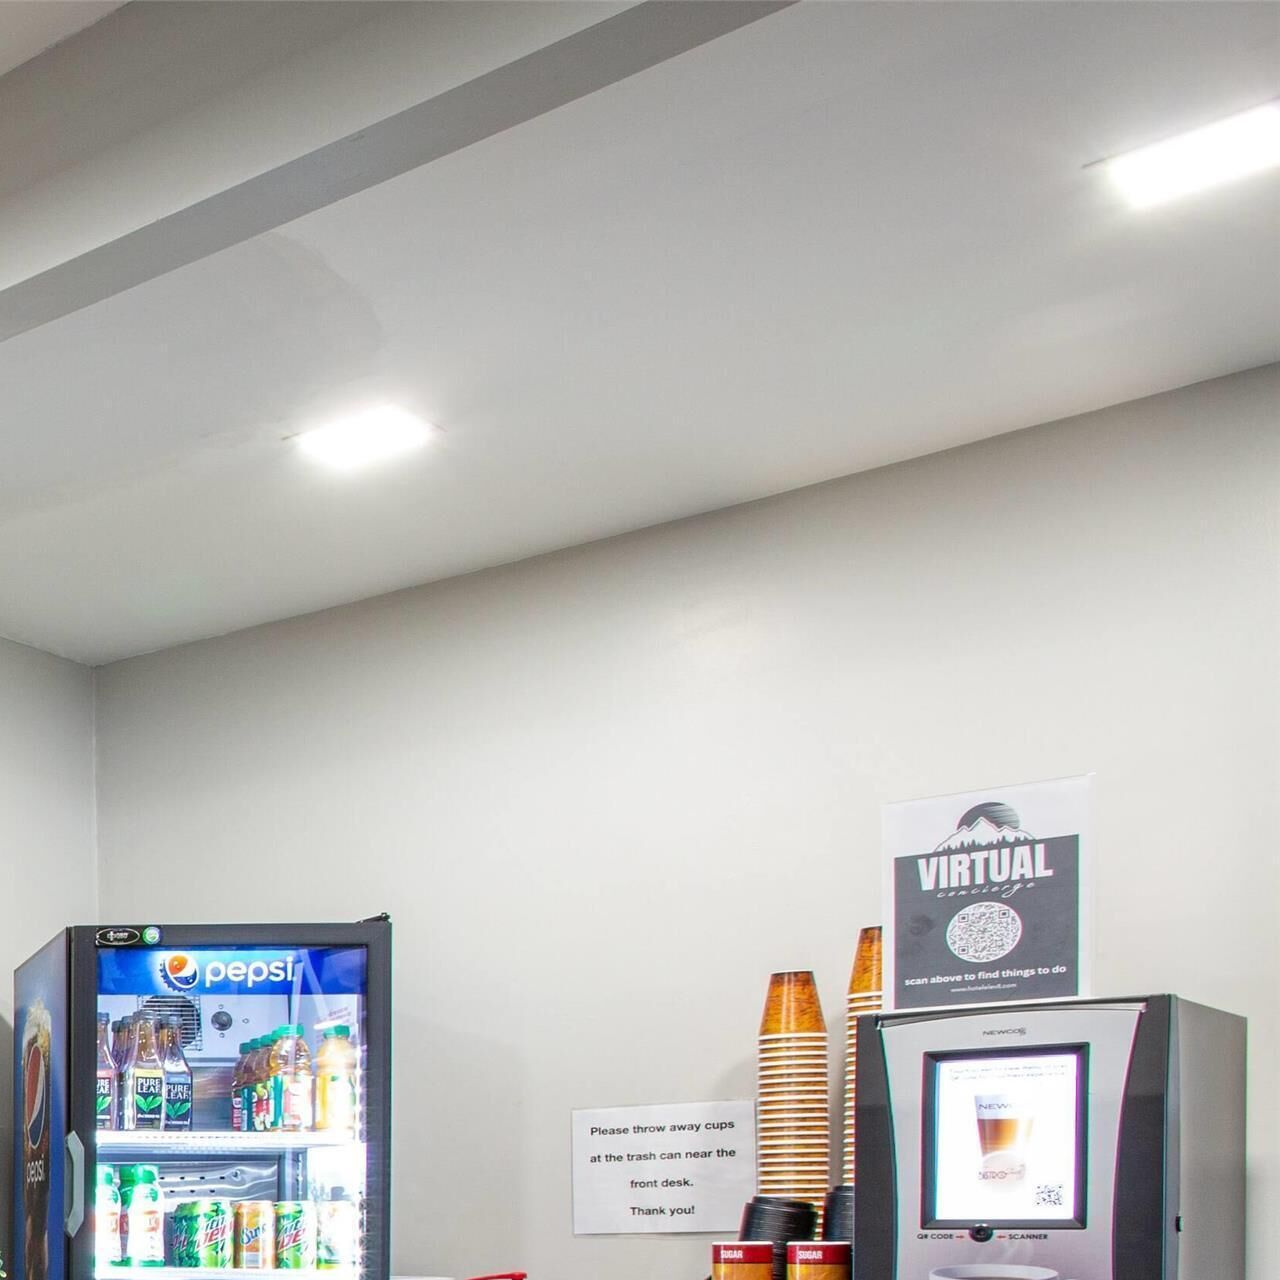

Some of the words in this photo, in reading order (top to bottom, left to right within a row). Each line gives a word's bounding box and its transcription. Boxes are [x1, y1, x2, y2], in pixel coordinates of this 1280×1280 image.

[917, 843, 1054, 891] VIRTUAL
[937, 882, 1036, 898] concierge
[205, 956, 295, 987] pepsi
[904, 975, 928, 986] scan
[929, 972, 962, 984] above
[964, 971, 976, 981] to
[978, 970, 999, 980] find
[1001, 966, 1036, 979] things
[1037, 966, 1050, 975] to
[1052, 965, 1067, 974] do
[137, 1078, 161, 1087] PURE
[165, 1083, 189, 1092] PURE
[137, 1085, 163, 1094] LEAF
[165, 1091, 189, 1100] LEAF
[590, 1126, 629, 1136] Please
[632, 1124, 666, 1134] throw
[669, 1122, 701, 1134] away
[704, 1120, 736, 1132] cups
[590, 1154, 601, 1163] at
[604, 1153, 624, 1162] the
[626, 1151, 656, 1161] trash
[659, 1151, 682, 1160] can
[685, 1149, 713, 1159] near
[716, 1148, 736, 1158] the
[26, 1155, 45, 1184] pepsi
[630, 1179, 658, 1188] front
[660, 1177, 694, 1187] desk.
[630, 1206, 666, 1216] Thank
[669, 1205, 695, 1217] you!
[720, 1250, 743, 1259] SUGAR
[798, 1251, 823, 1259] SUGAR
